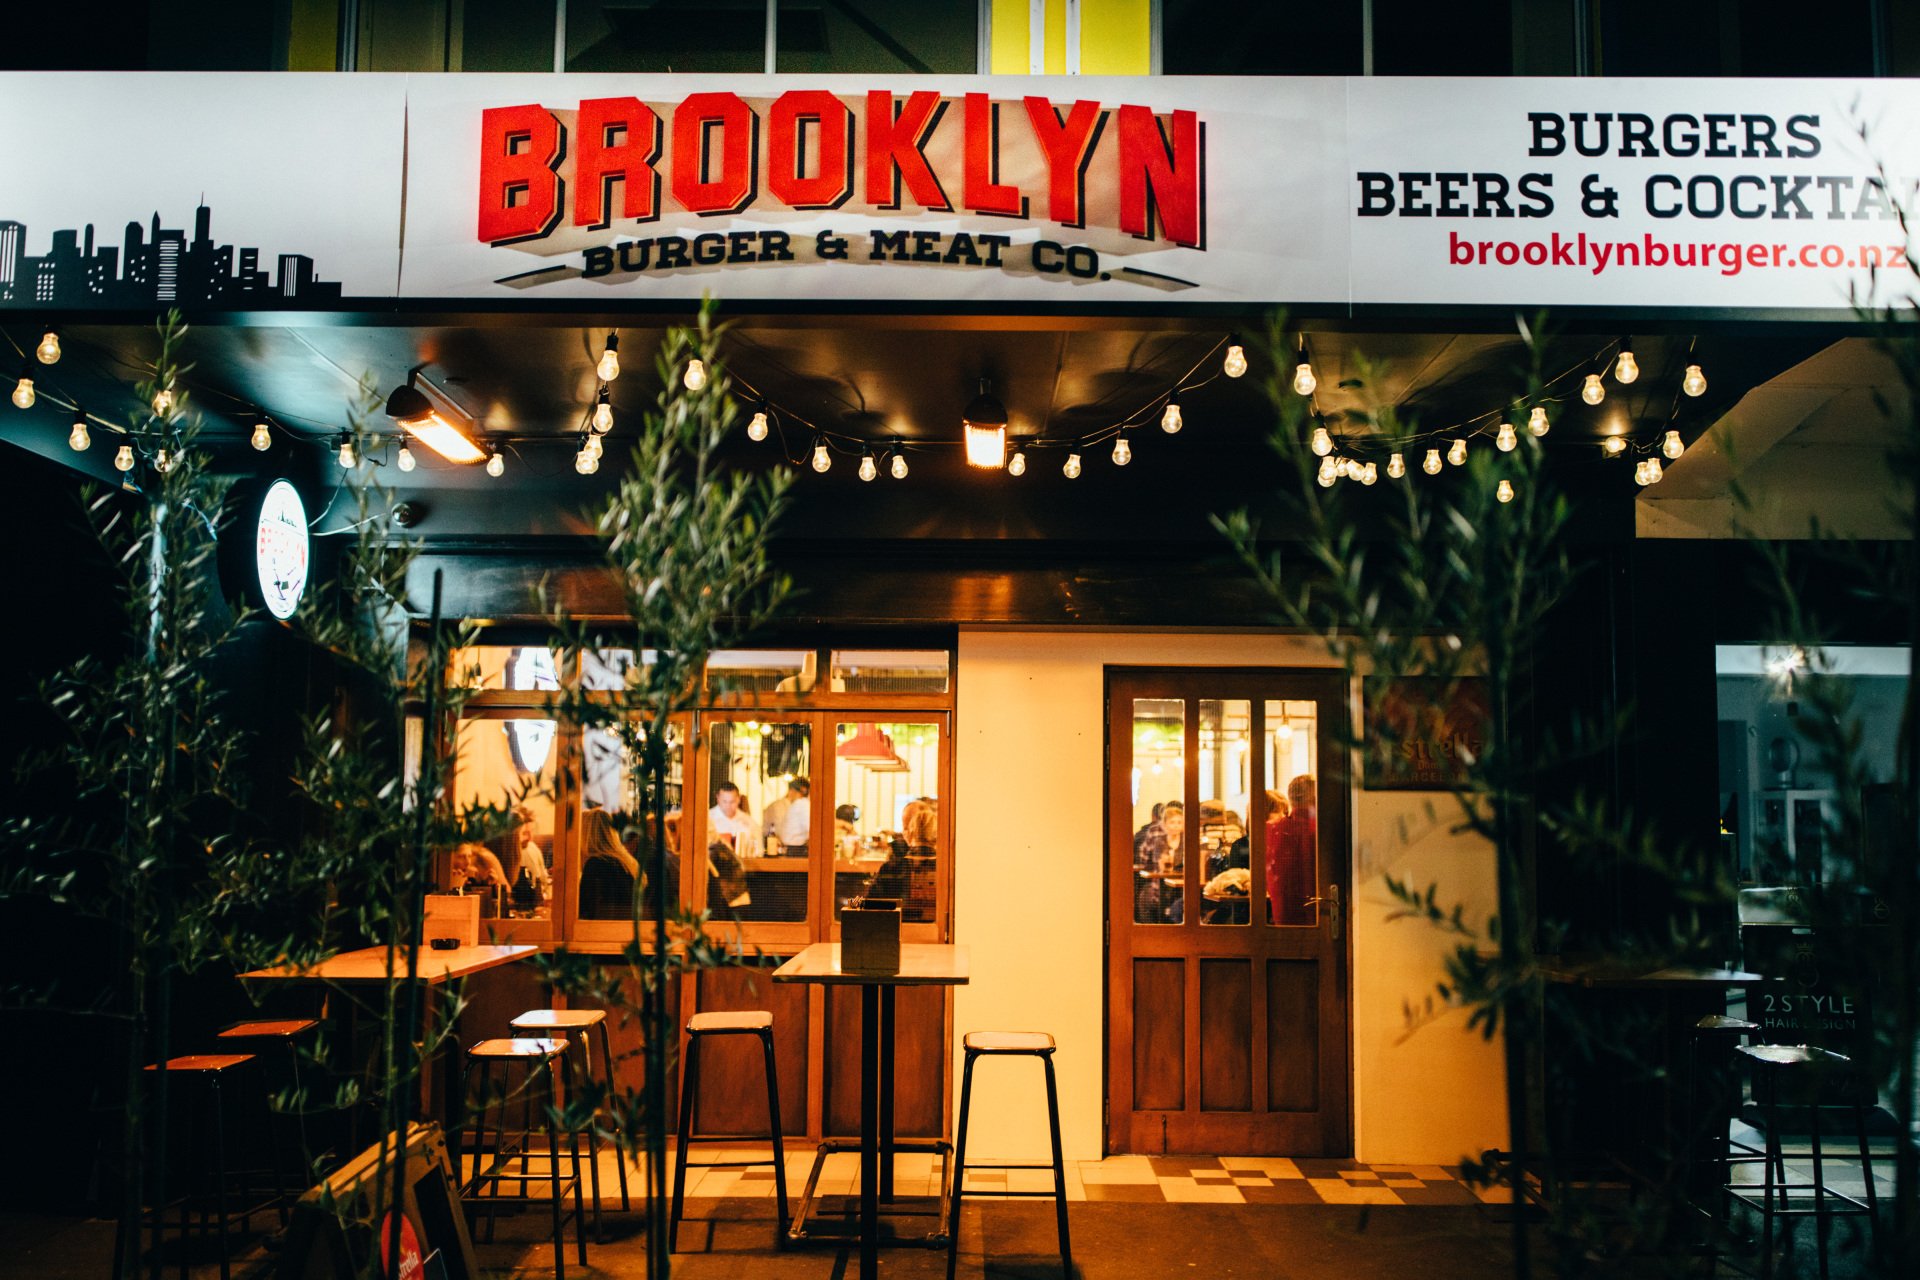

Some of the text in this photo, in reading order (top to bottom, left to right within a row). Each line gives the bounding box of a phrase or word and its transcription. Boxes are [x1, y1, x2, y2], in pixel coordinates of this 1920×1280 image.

[1527, 112, 1822, 158] BURGERS
[478, 89, 1207, 252] BROOKLYN
[1357, 172, 1554, 218] BEERS
[1580, 173, 1619, 218] &
[581, 229, 1111, 281] BURGER & MEAT CO.
[1449, 231, 1908, 276] brooklynburger.co.nz
[1763, 994, 1855, 1014] 2STYLE
[1765, 1017, 1800, 1029] HAIR
[1803, 1018, 1856, 1030] SIGN
